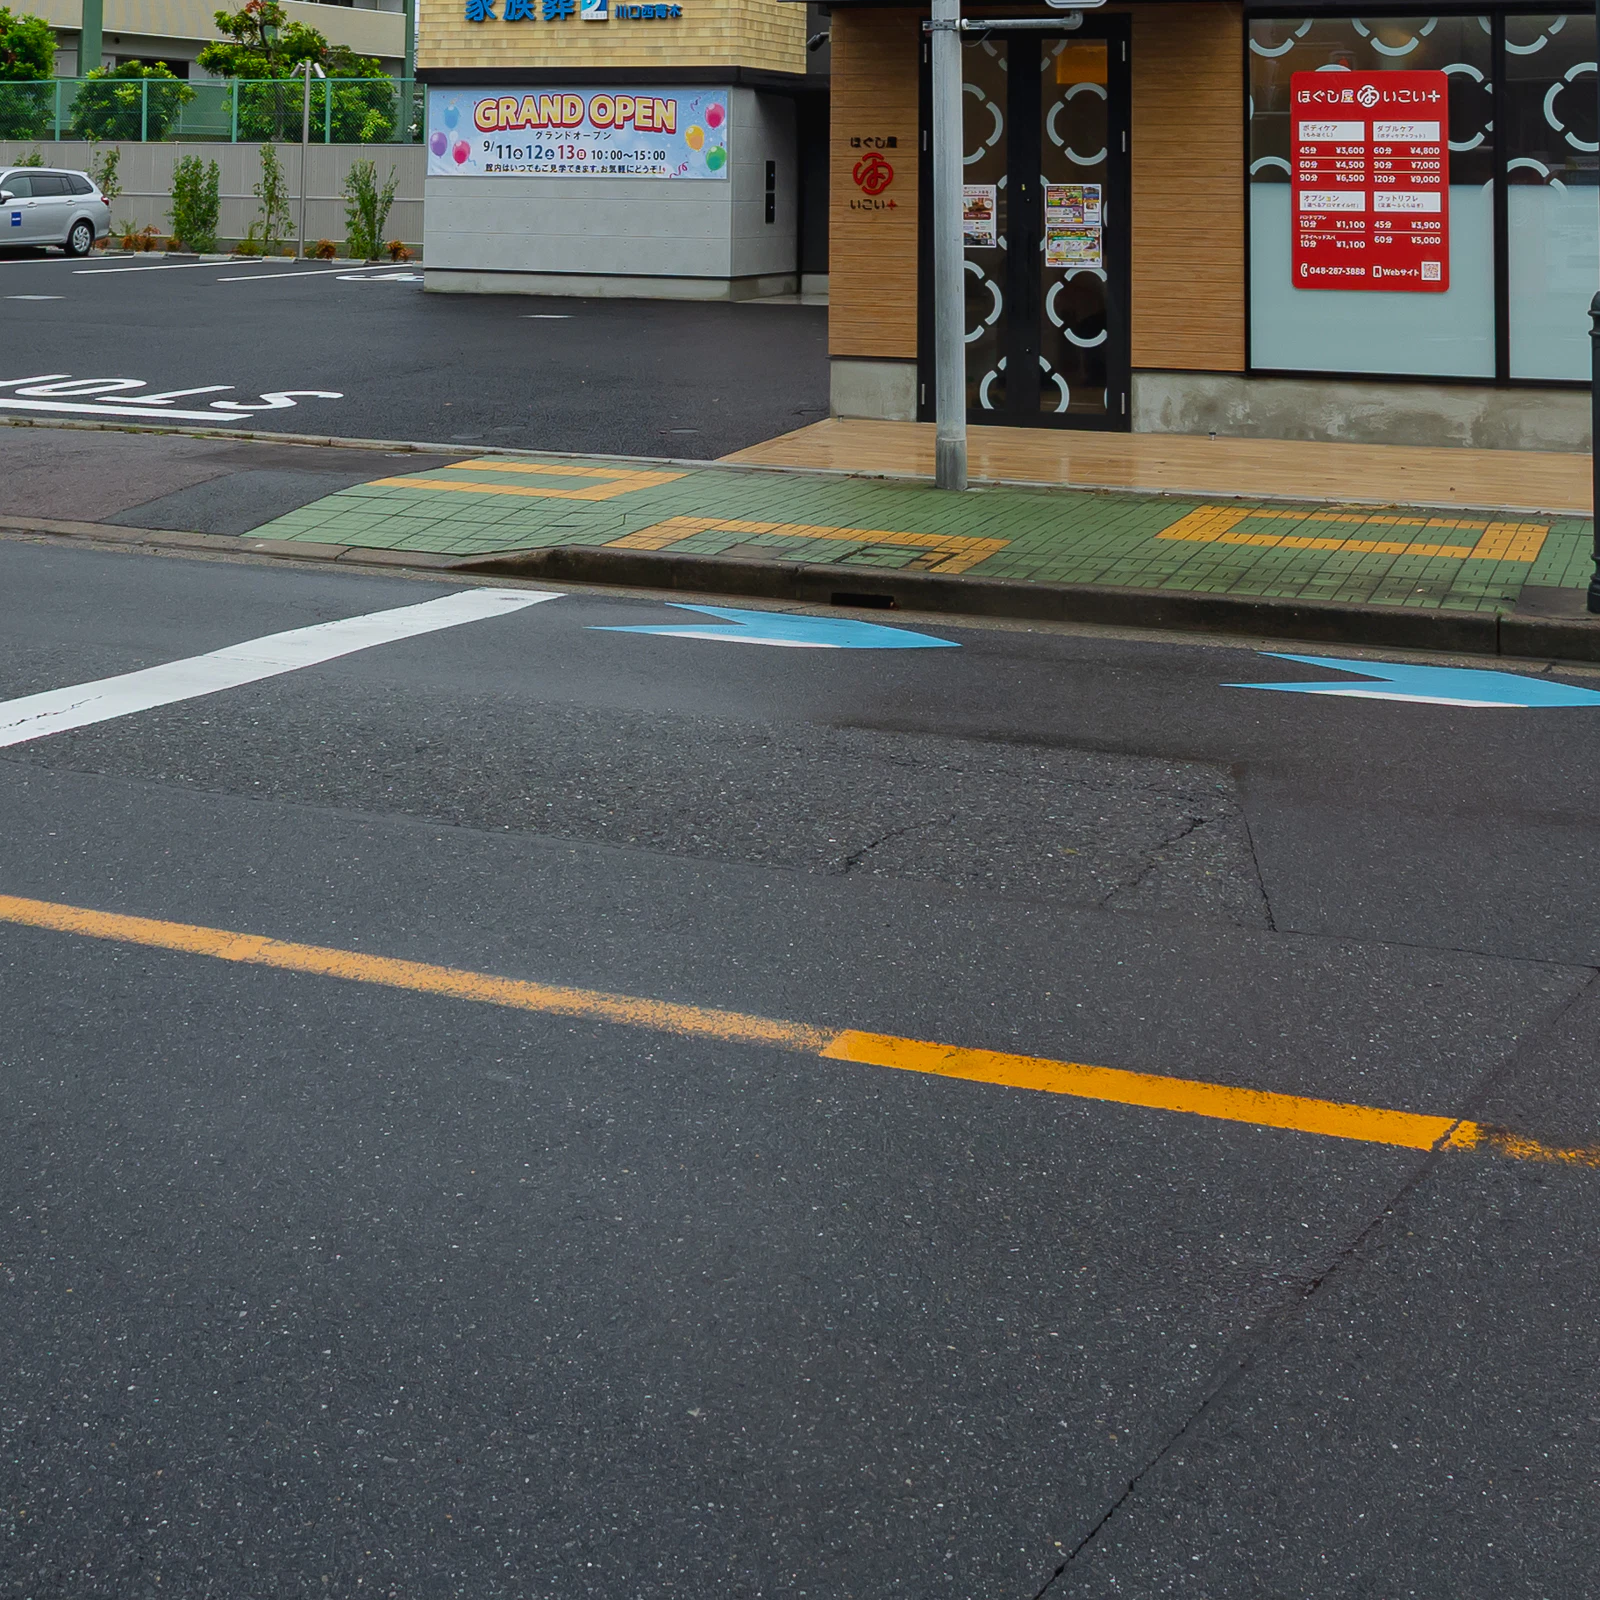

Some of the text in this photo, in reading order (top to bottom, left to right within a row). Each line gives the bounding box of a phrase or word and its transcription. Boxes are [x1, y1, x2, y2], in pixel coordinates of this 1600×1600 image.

[614, 3, 683, 20] 川口西青木
[1297, 89, 1354, 103] ほぐし屋
[473, 93, 678, 135] GRAND OPEN
[535, 131, 612, 140] グランドオープン
[1382, 268, 1420, 277] Webサイト
